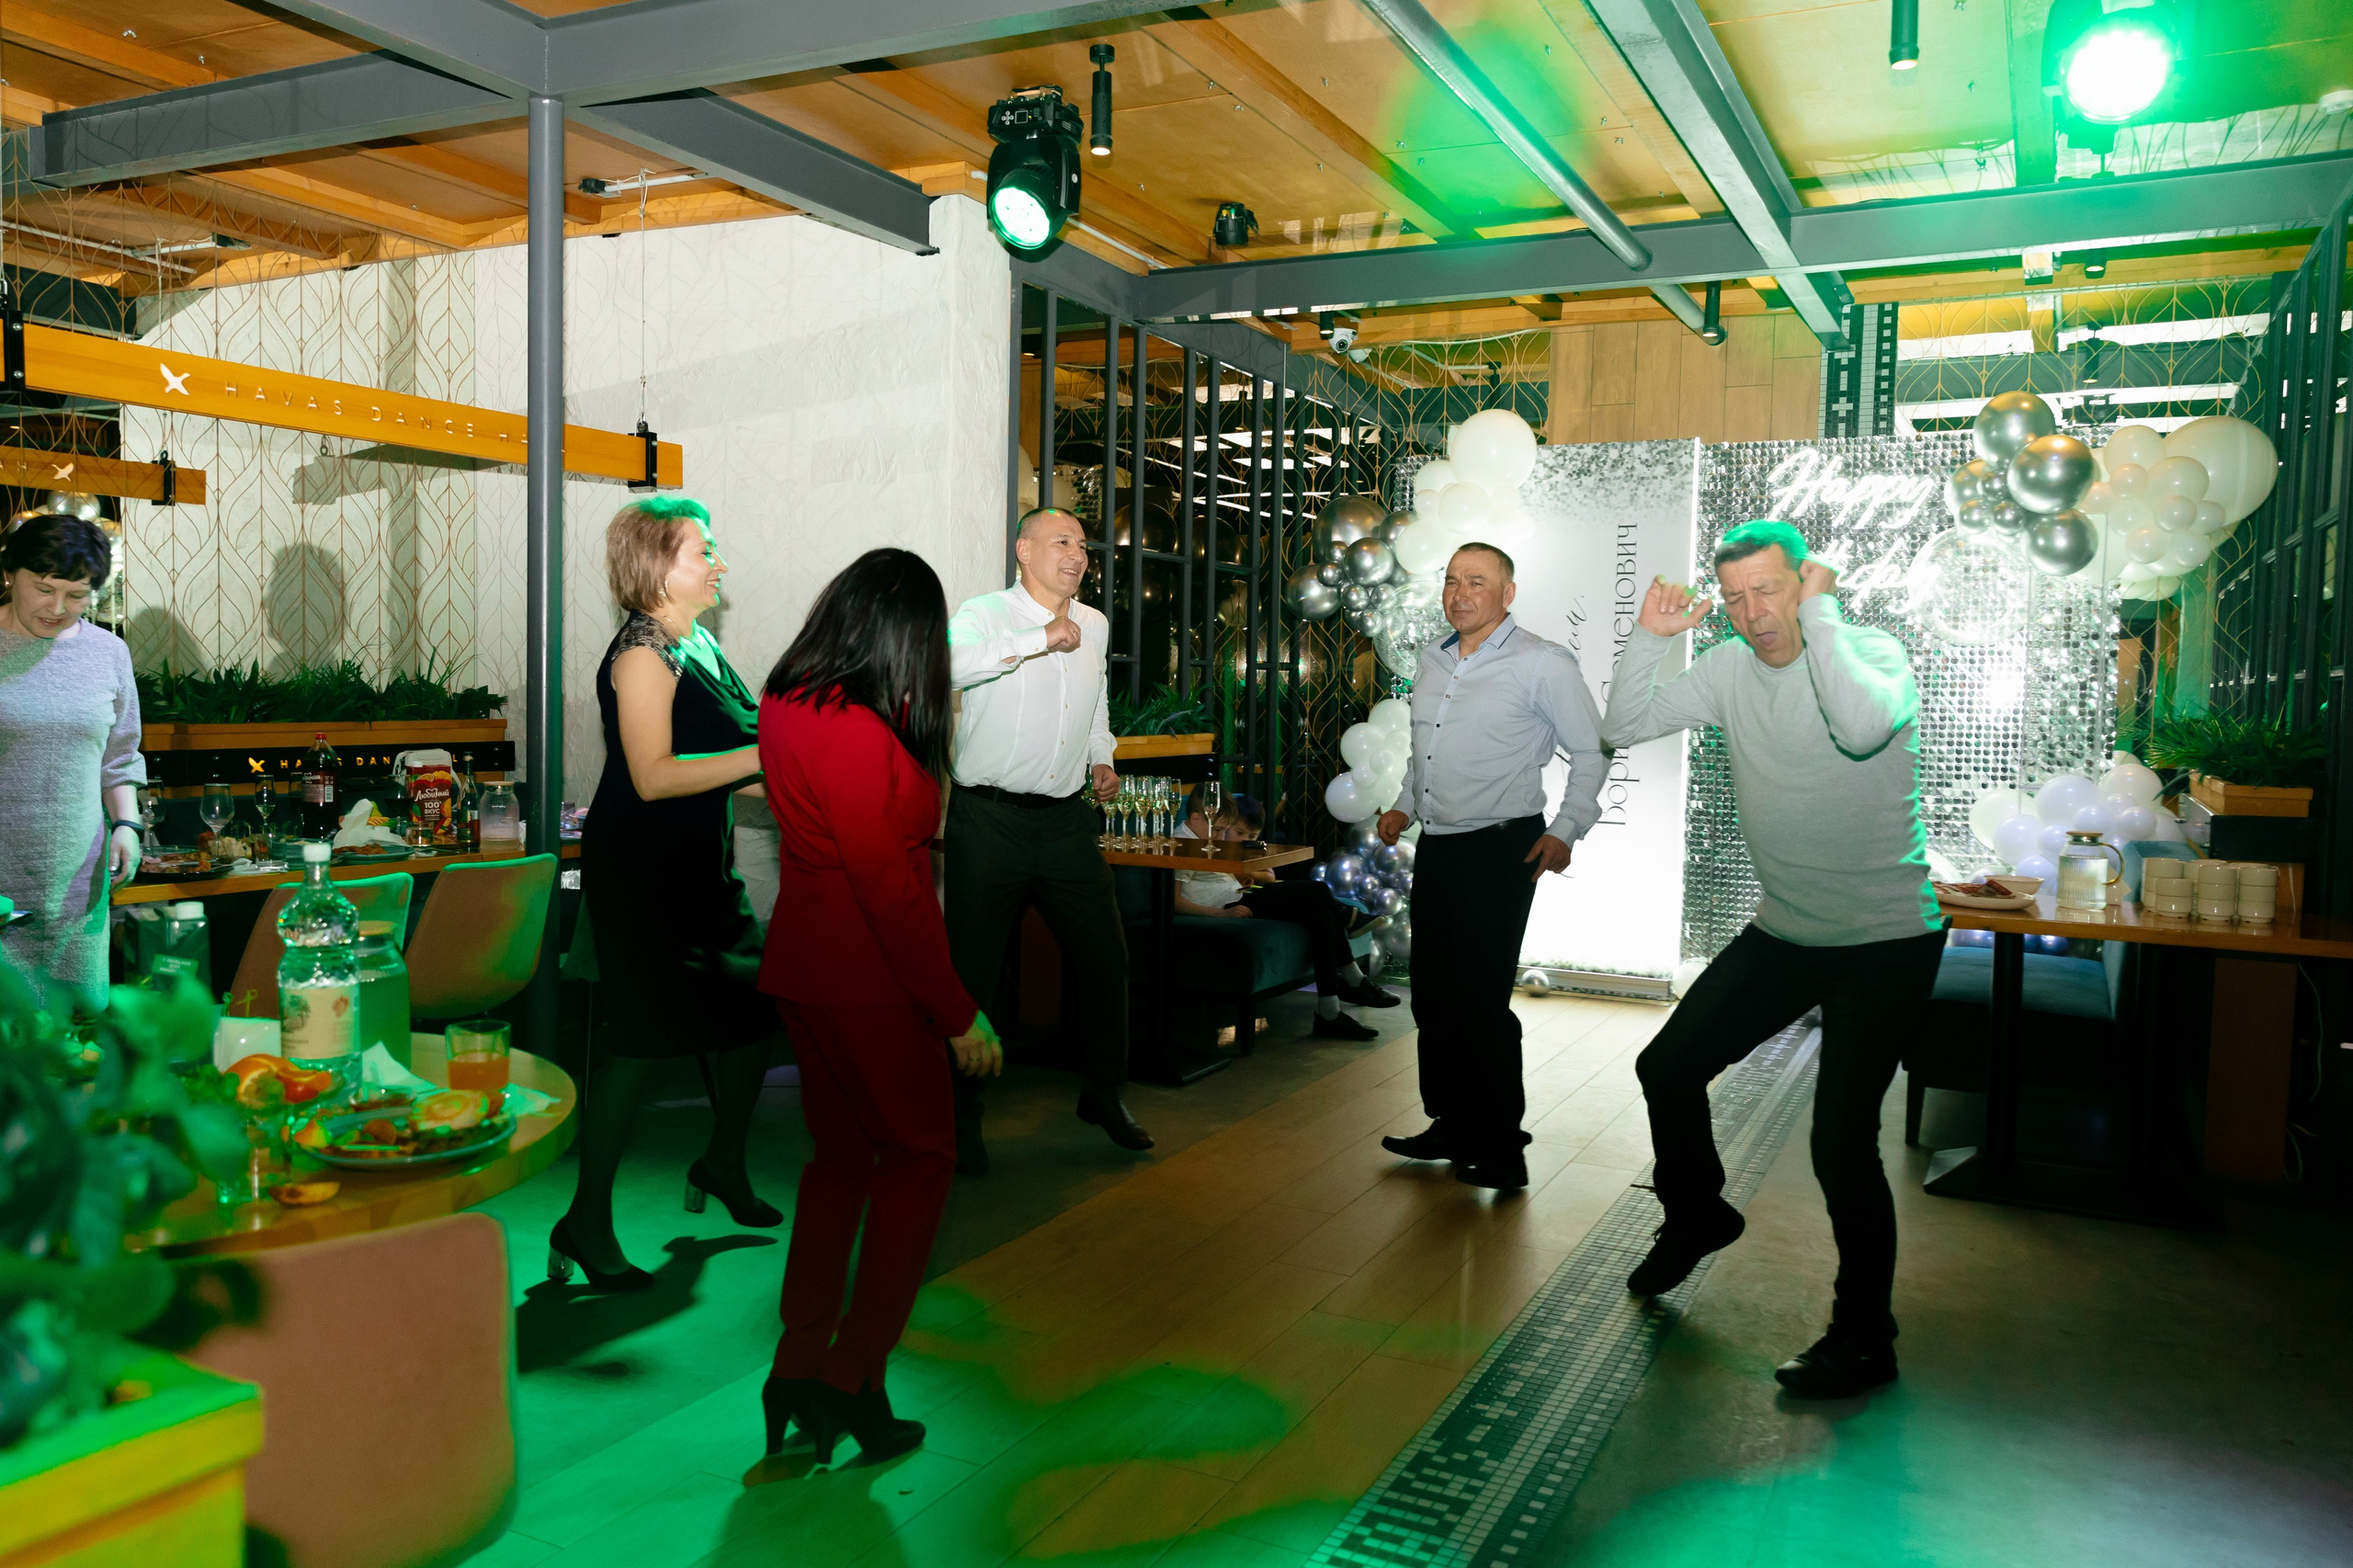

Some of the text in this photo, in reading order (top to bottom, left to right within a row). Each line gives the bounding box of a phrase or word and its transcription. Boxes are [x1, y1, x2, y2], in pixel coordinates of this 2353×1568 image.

[225, 381, 343, 416] HAVAS
[371, 405, 474, 438] DANCE
[1767, 448, 1935, 529] Happy
[356, 756, 392, 766] DAN
[1597, 746, 1640, 825] Бори
[415, 788, 449, 801] Любимый
